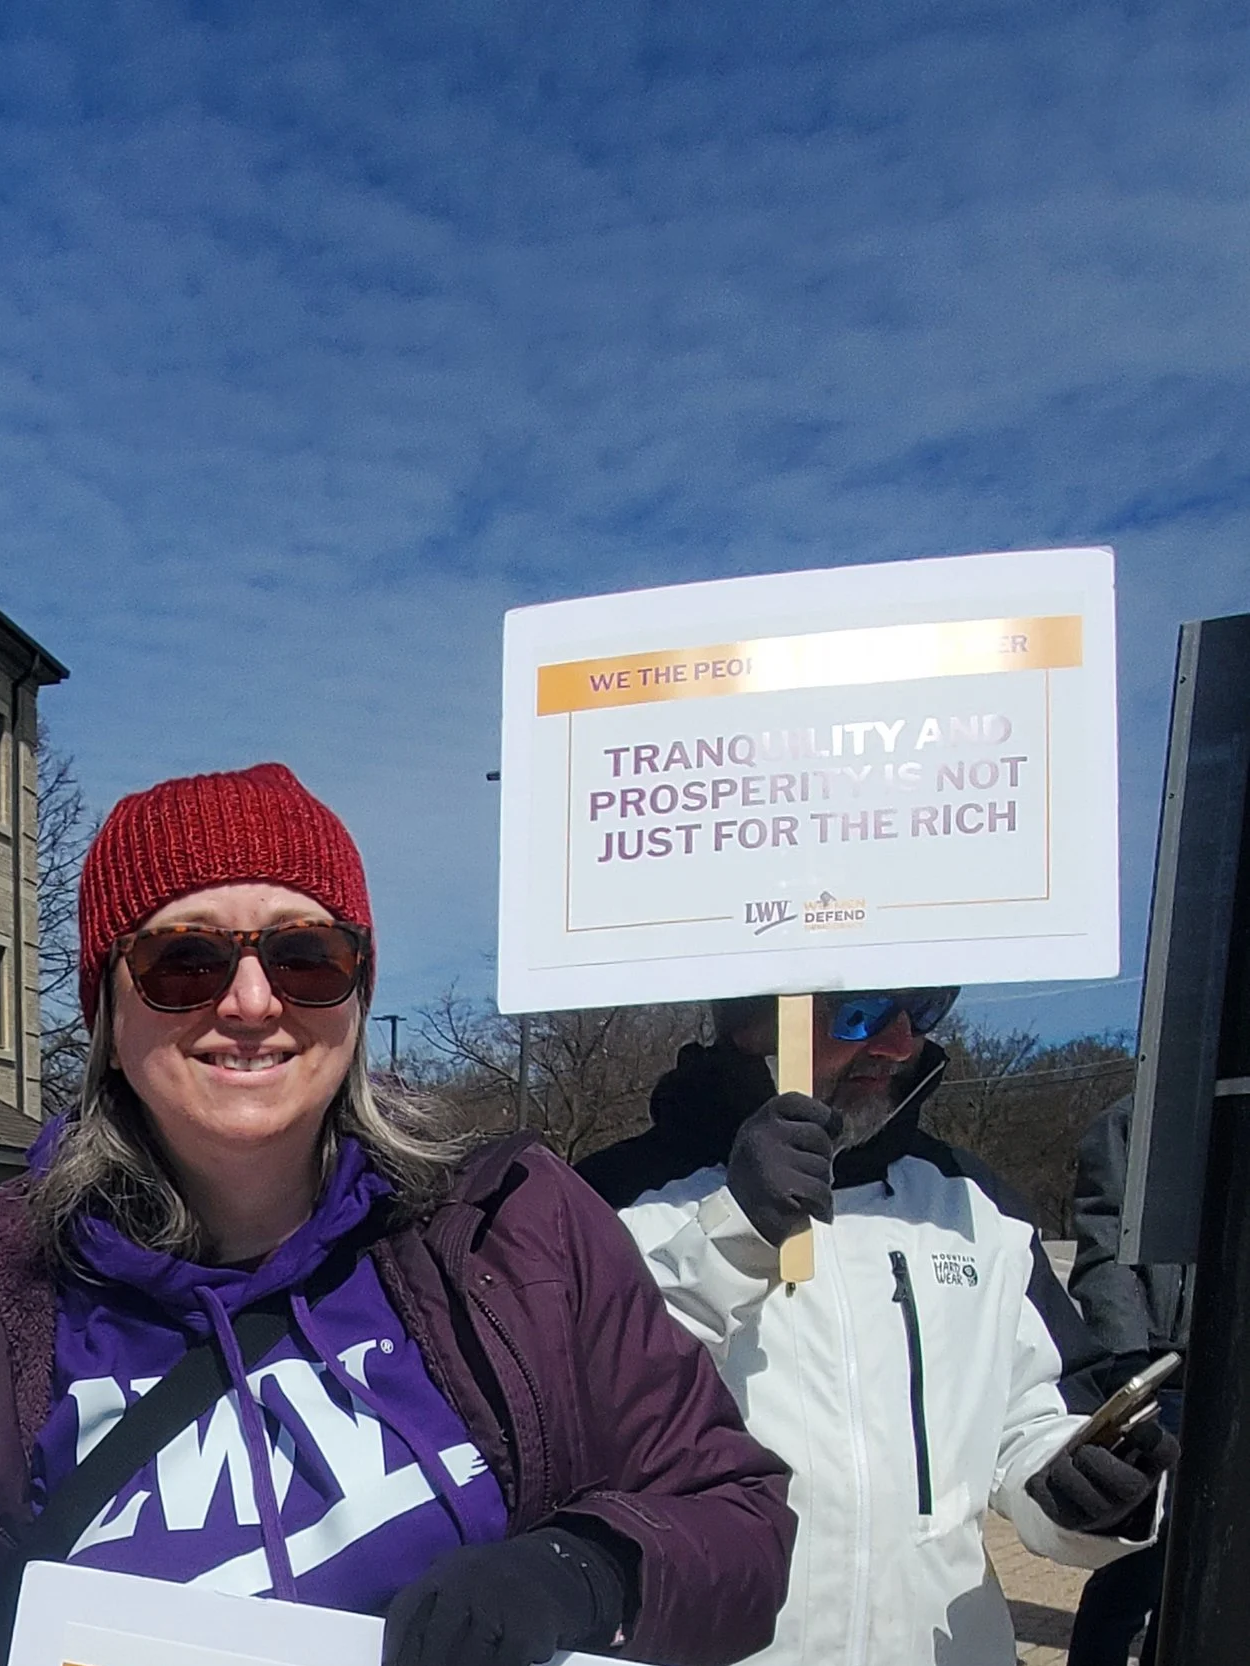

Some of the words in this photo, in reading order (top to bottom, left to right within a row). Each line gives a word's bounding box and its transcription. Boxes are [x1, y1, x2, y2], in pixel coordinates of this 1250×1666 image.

[589, 671, 631, 692] WE
[637, 664, 688, 686] THE
[603, 720, 906, 778] TRANQUILITY
[915, 714, 1013, 750] AND
[589, 764, 874, 823] PROSPERITY
[883, 760, 924, 793] IS
[935, 756, 1029, 793] NOT
[597, 822, 703, 863] JUST
[713, 816, 799, 852] FOR
[809, 808, 899, 844] THE
[911, 800, 1017, 837] RICH
[744, 900, 791, 924] LWV
[804, 909, 866, 924] DEFEND
